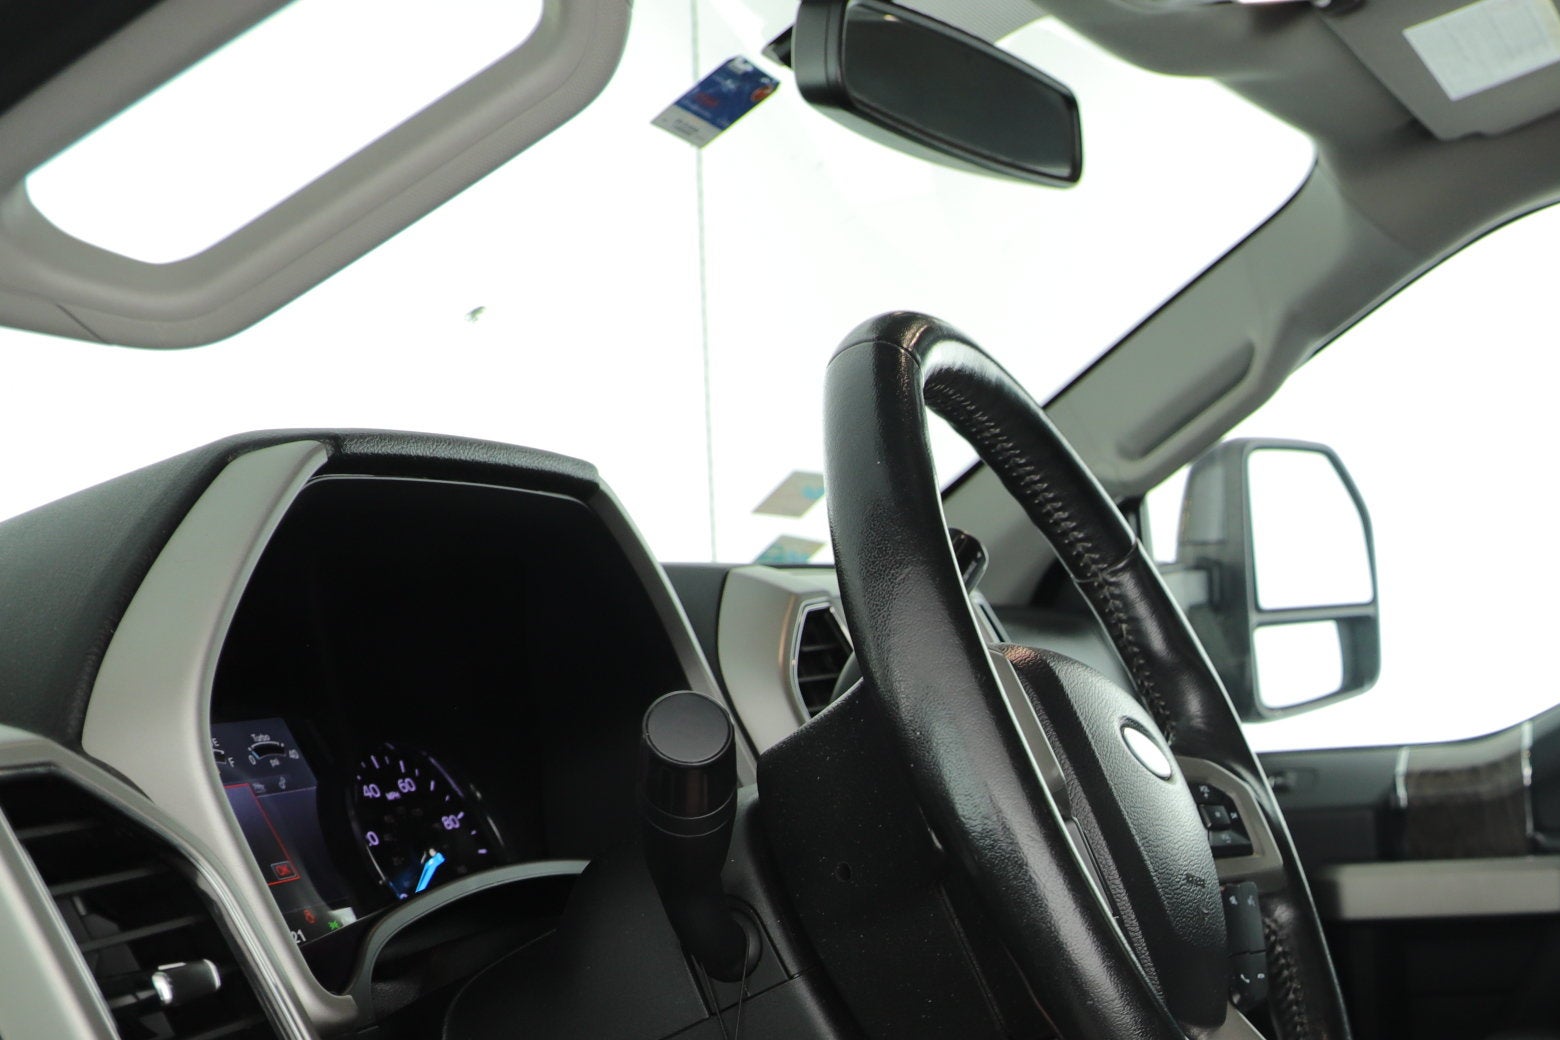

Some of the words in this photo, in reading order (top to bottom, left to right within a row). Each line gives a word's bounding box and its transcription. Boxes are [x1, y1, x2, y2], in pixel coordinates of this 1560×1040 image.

[363, 784, 381, 799] 40
[398, 777, 416, 793] 60
[441, 814, 460, 830] 80
